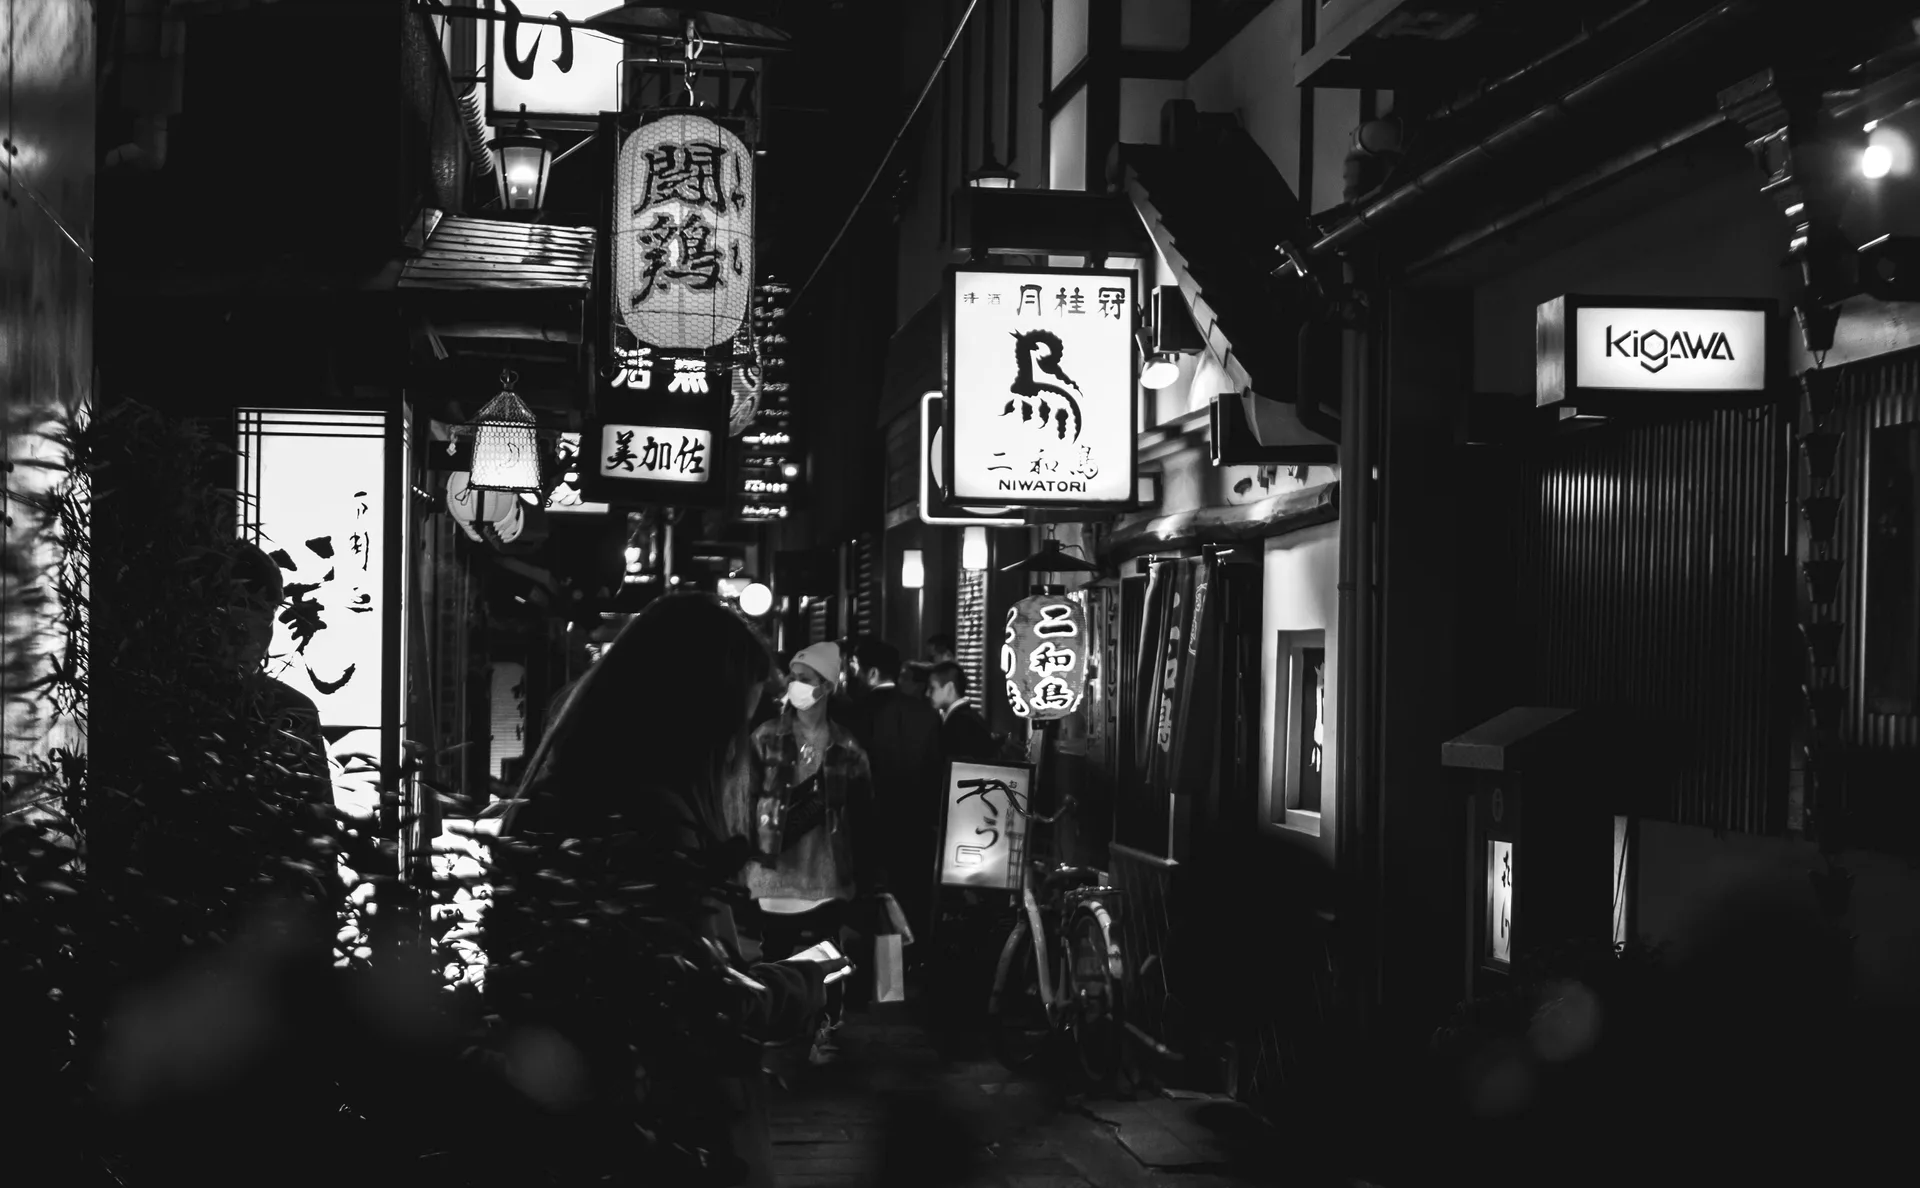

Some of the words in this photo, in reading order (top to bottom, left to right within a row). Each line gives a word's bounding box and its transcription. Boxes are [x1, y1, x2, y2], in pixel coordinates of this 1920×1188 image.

[632, 144, 728, 308] 闘鶏
[963, 291, 1002, 306] 清酒
[1016, 284, 1126, 320] 月桂冠
[605, 429, 706, 474] 美加佐
[987, 445, 1099, 480] 二和鳥
[998, 479, 1087, 493] NIWATORI
[1029, 604, 1079, 710] 二和鳥
